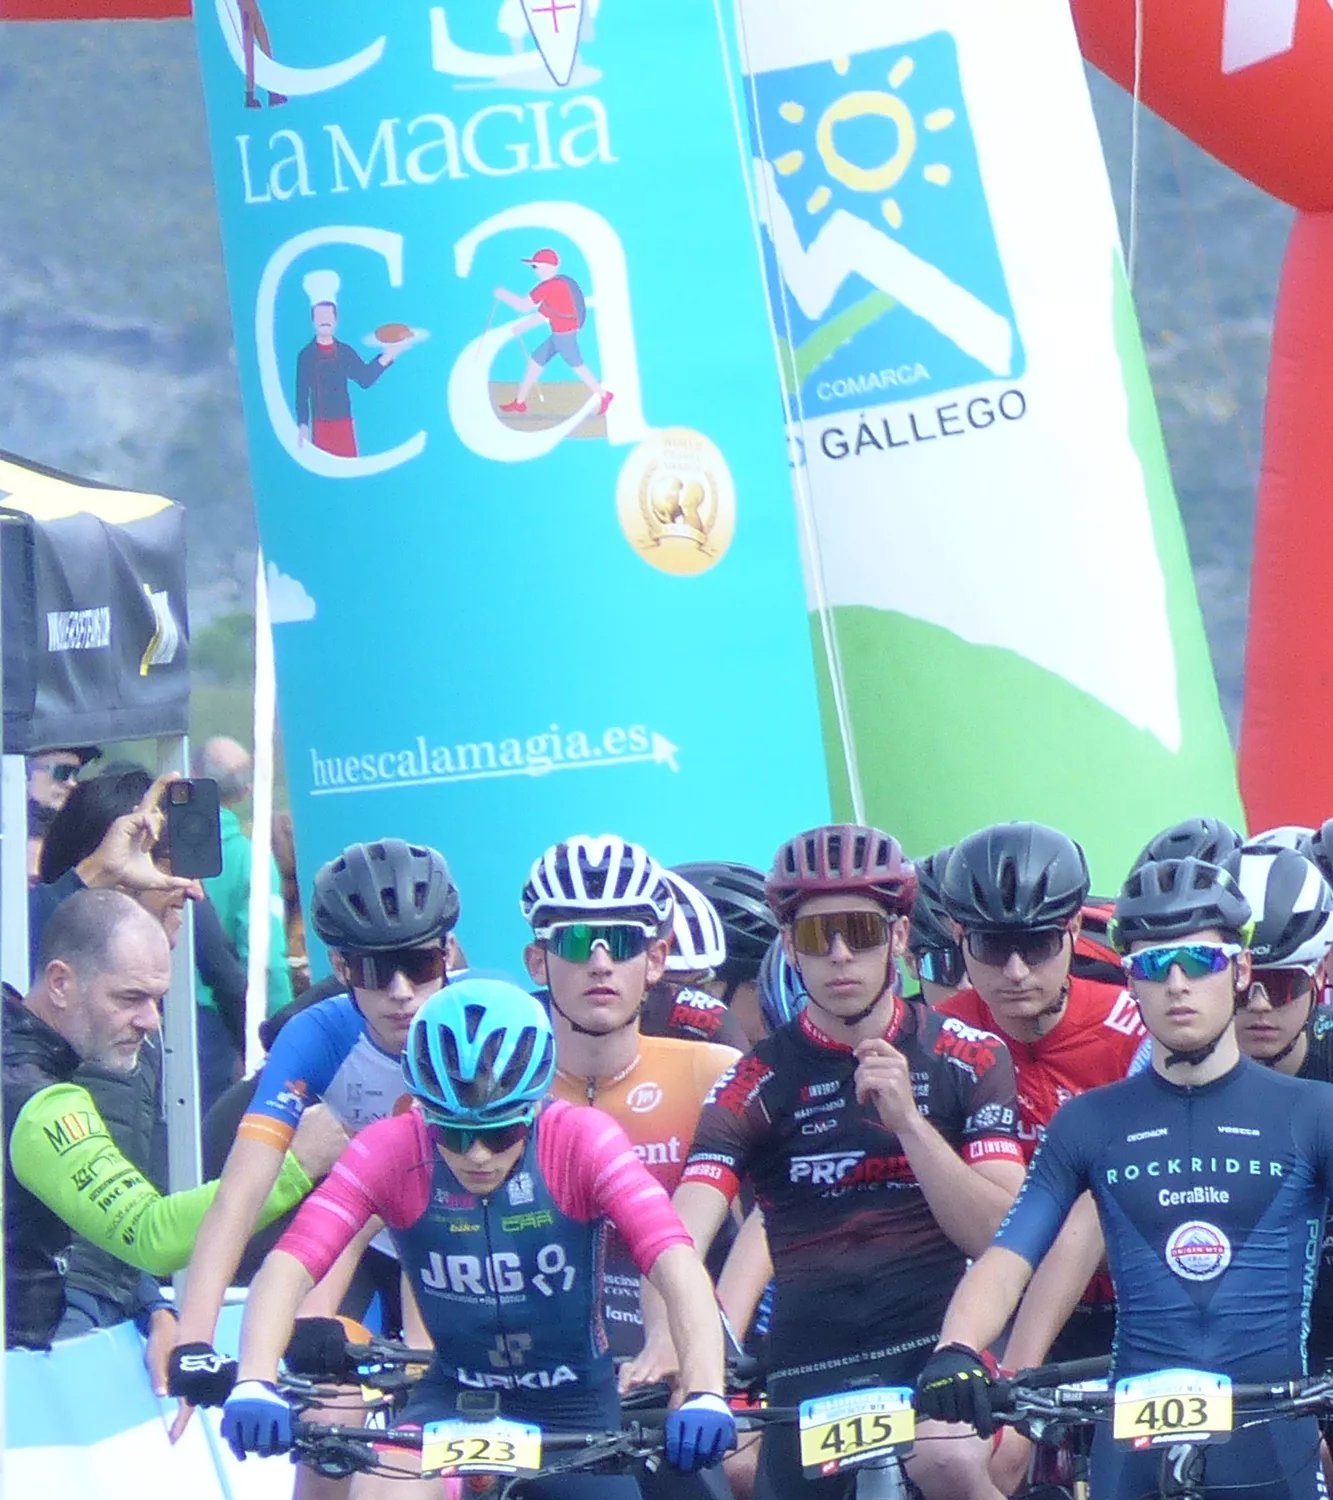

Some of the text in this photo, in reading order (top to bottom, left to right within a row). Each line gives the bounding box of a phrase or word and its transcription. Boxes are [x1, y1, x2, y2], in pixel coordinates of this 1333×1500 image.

[816, 361, 932, 402] COMARCA
[310, 722, 651, 788] huescalamagia.es
[1106, 1157, 1284, 1185] ROCKRIDER
[1158, 1185, 1230, 1207] CeraBike
[420, 1251, 525, 1295] JRG
[1135, 1397, 1208, 1431] 403
[443, 1437, 517, 1462] 523
[821, 1414, 893, 1452] 415
